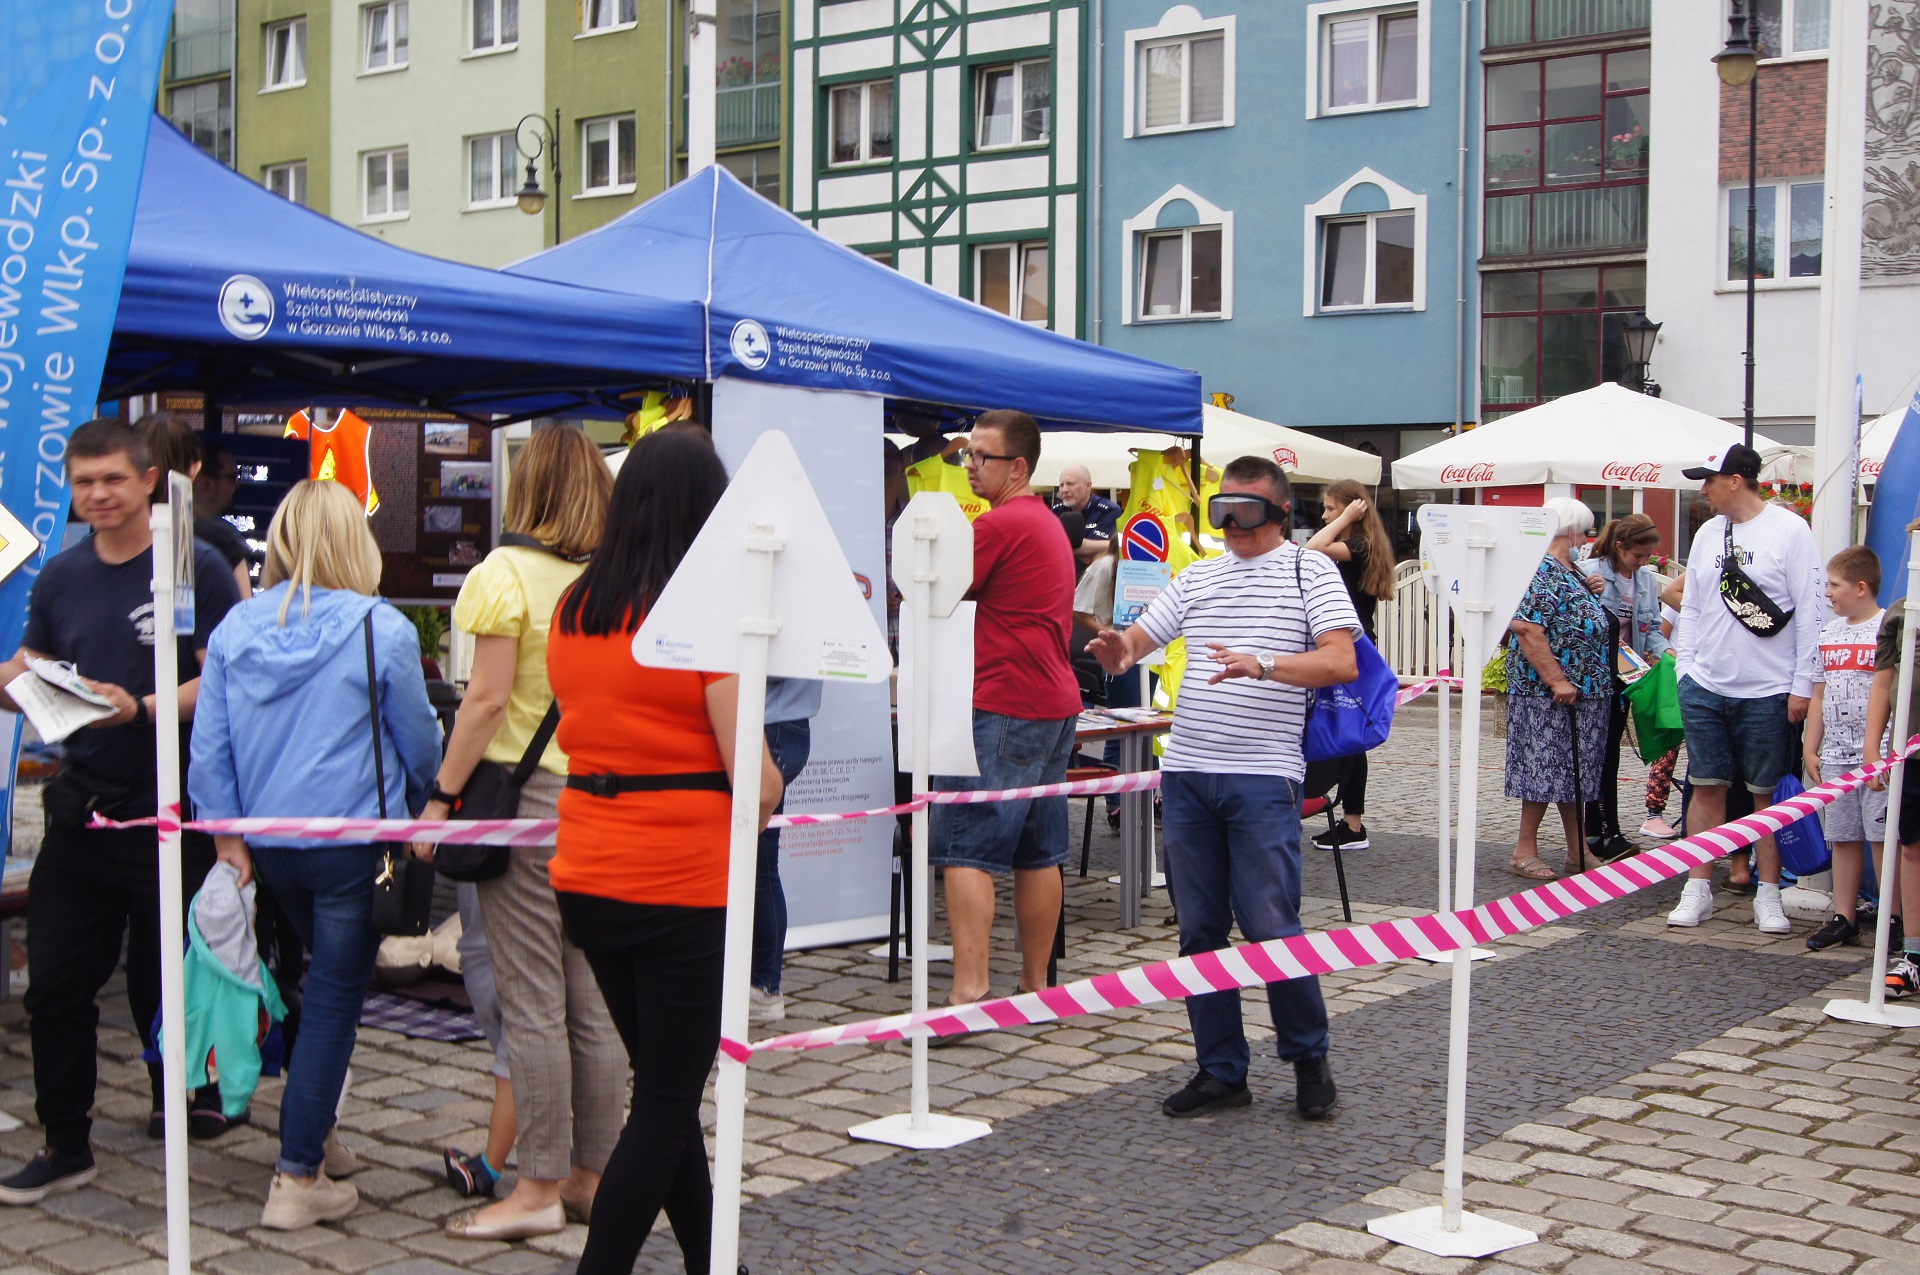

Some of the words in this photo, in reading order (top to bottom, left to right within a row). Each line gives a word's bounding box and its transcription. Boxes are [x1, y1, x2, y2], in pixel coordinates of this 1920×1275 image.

[88, 74, 116, 101] z
[61, 117, 112, 193] Sp.
[36, 205, 99, 336] Wlkp.
[283, 282, 417, 311] Wielospecjalistyczny
[286, 300, 333, 320] Szpital
[334, 302, 409, 324] Wojewódzki
[286, 322, 298, 334] w
[300, 319, 361, 338] Gorzowie
[363, 322, 398, 343] Wlkp.
[399, 325, 419, 344] Sp.
[421, 331, 429, 343] z
[430, 331, 452, 344] o.o.
[775, 325, 871, 351] Wielospecjalistyczny
[777, 340, 810, 356] Szpital
[811, 344, 863, 362] Wojewódzki
[779, 357, 786, 366] w
[788, 355, 829, 372] Gorzowie
[830, 361, 855, 377] Wlkp.
[855, 365, 870, 379] Sp.
[870, 370, 876, 378] z
[1441, 462, 1497, 484] Coca-Cola
[1601, 461, 1664, 482] Coca-Cola
[1451, 580, 1460, 595] 4
